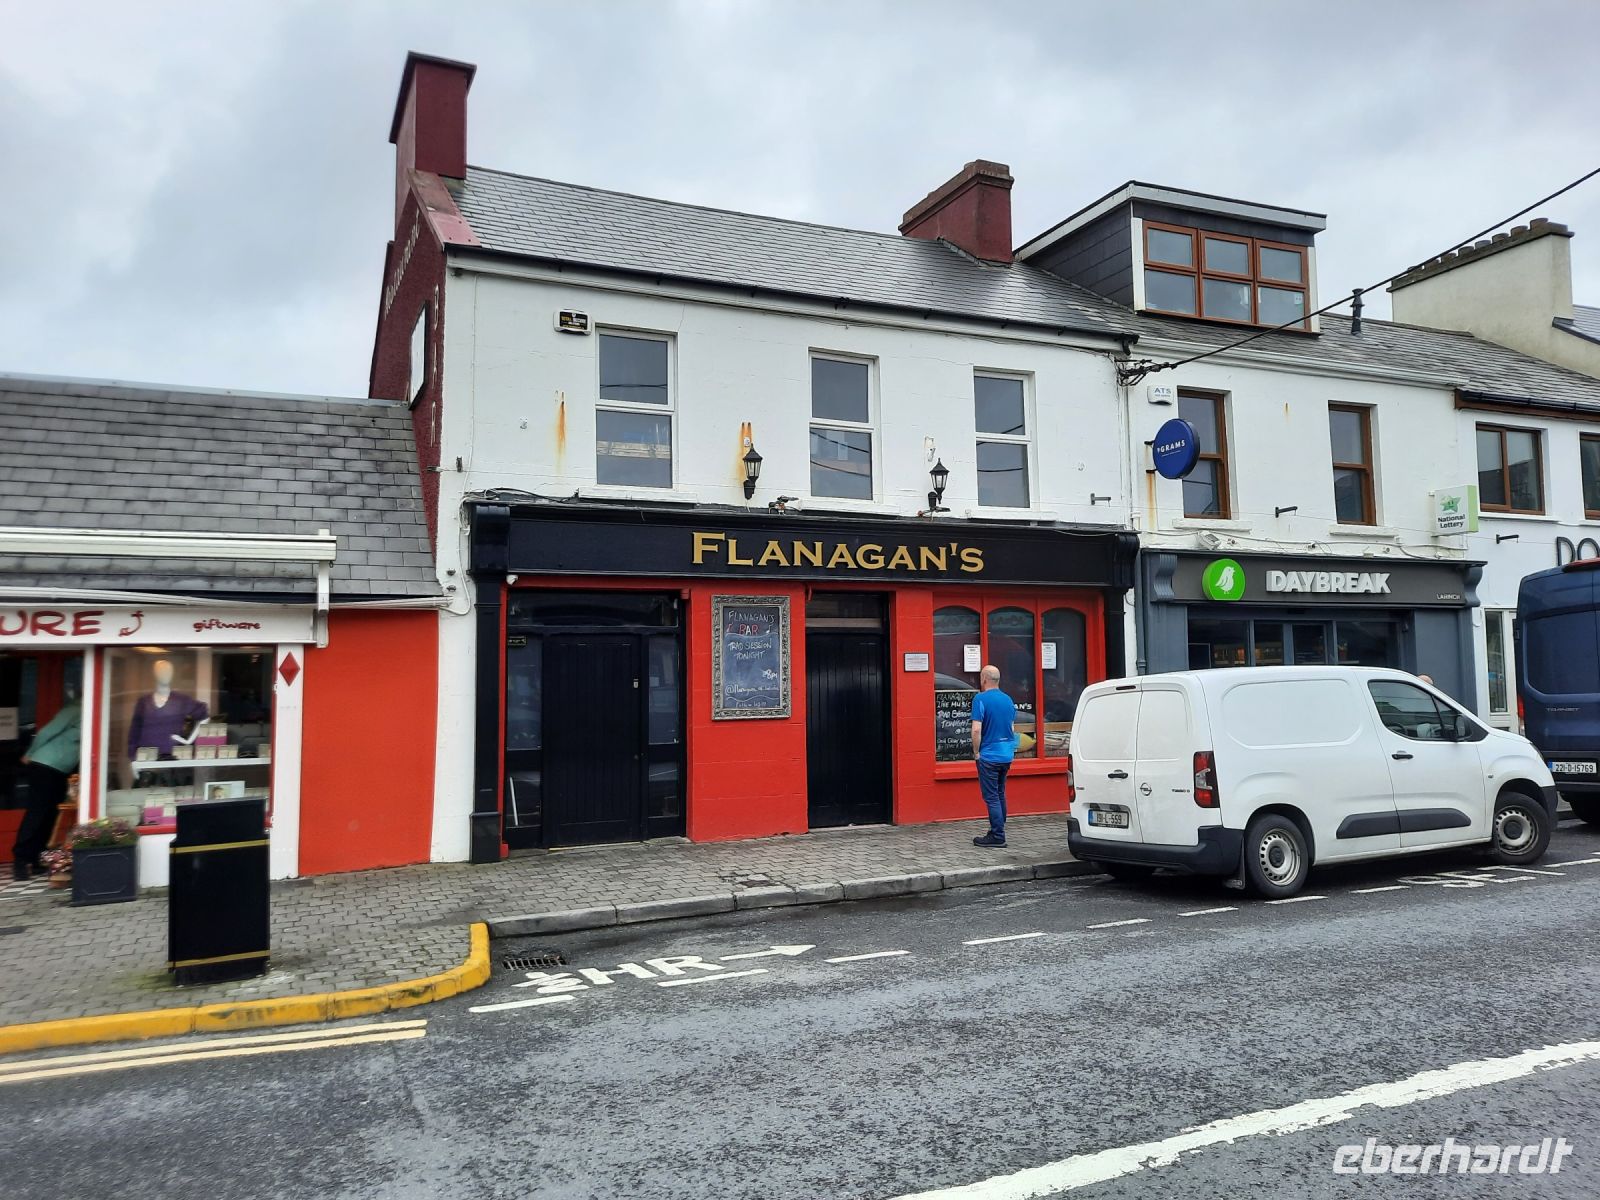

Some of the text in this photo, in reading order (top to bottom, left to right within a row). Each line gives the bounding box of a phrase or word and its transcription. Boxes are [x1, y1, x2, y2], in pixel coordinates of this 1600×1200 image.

[1437, 513, 1466, 524] National
[1439, 520, 1464, 529] Lottery
[692, 531, 985, 573] FLANAGAN'S
[1266, 570, 1392, 593] DAYBREAK
[193, 618, 261, 633] giftware
[739, 623, 759, 636] BAR
[734, 651, 765, 661] TONIGHT
